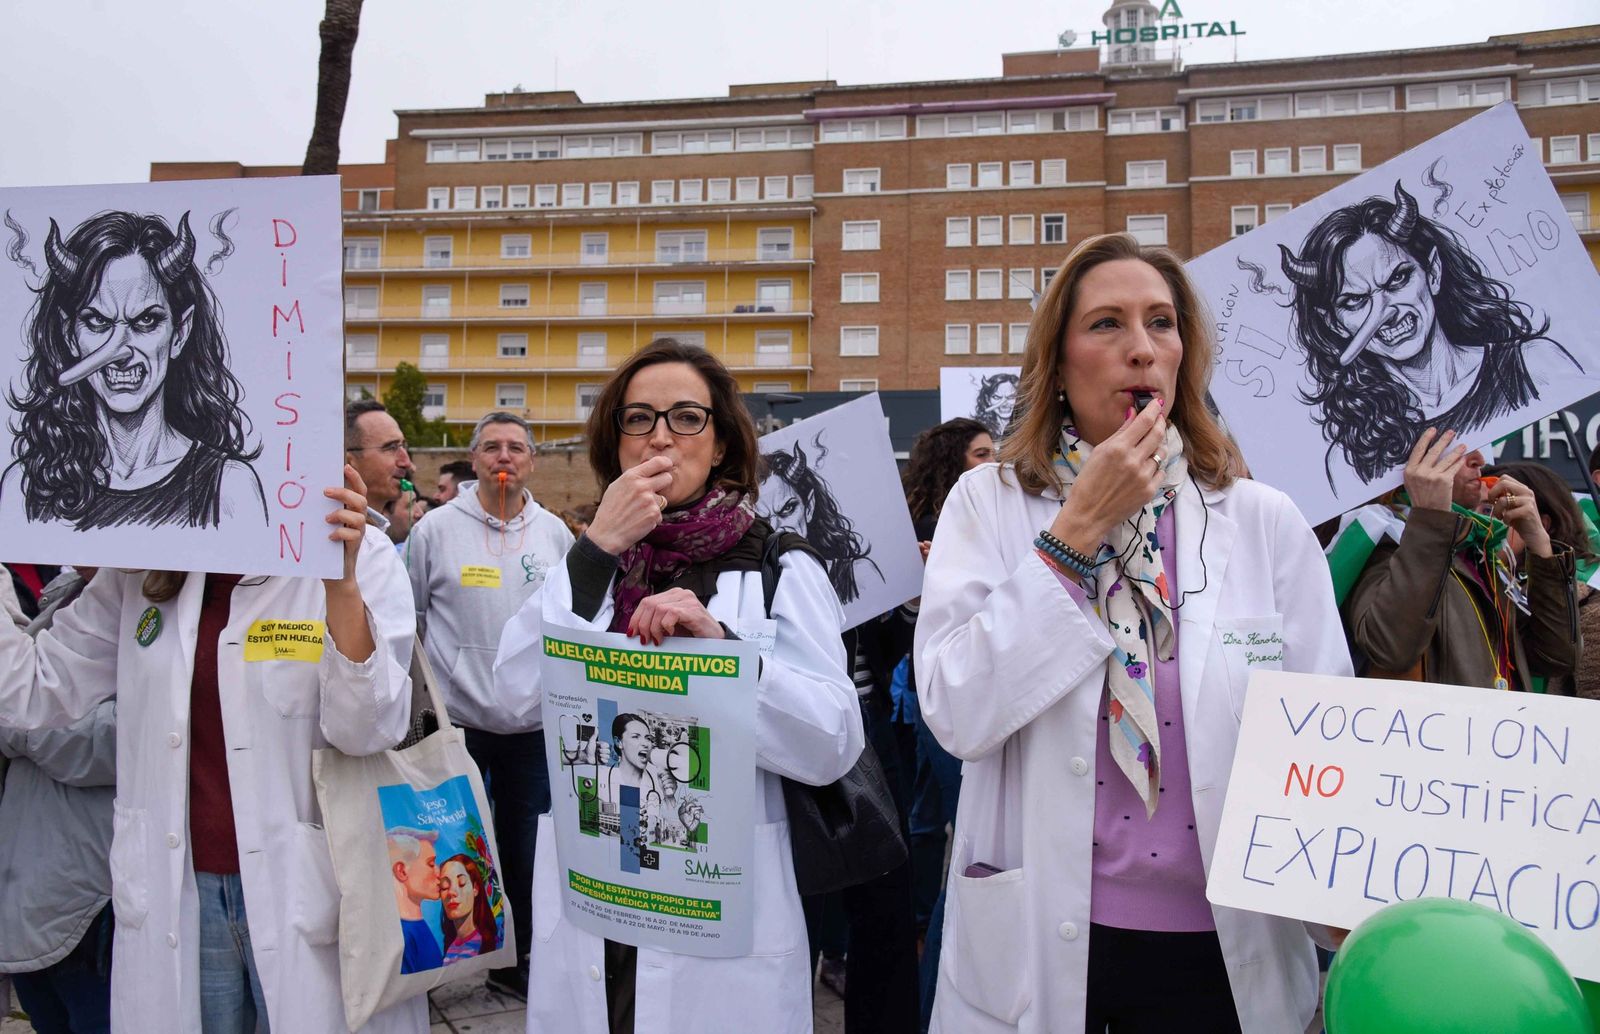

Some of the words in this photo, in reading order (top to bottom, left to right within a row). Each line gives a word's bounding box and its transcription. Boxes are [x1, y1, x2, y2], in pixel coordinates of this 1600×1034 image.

[1092, 21, 1246, 45] HOSPITAL
[1486, 209, 1561, 277] NO
[247, 634, 273, 644] ESTOY
[275, 633, 288, 642] EN
[290, 634, 323, 645] HUELGA
[261, 623, 276, 632] SOY
[545, 642, 607, 663] HUELGA
[609, 651, 737, 675] FACULTATIVOS
[588, 665, 684, 692] INDEFINIDA
[1280, 697, 1569, 765] VOCACIÓN
[1283, 762, 1345, 798] NO
[684, 858, 720, 880] SMA
[570, 881, 613, 902] PROFESIÓN
[614, 895, 649, 910] MÉDICA
[592, 881, 605, 889] UN
[606, 884, 649, 900] ESTATUTO
[650, 893, 685, 906] PROPIO
[686, 899, 699, 908] DE
[700, 901, 713, 909] LA
[604, 907, 613, 915] DE
[613, 910, 642, 921] FEBRERO
[669, 920, 680, 928] DE
[679, 922, 704, 931] MARZO
[628, 920, 637, 928] 22
[637, 922, 647, 930] DE
[646, 924, 666, 932] MAYO
